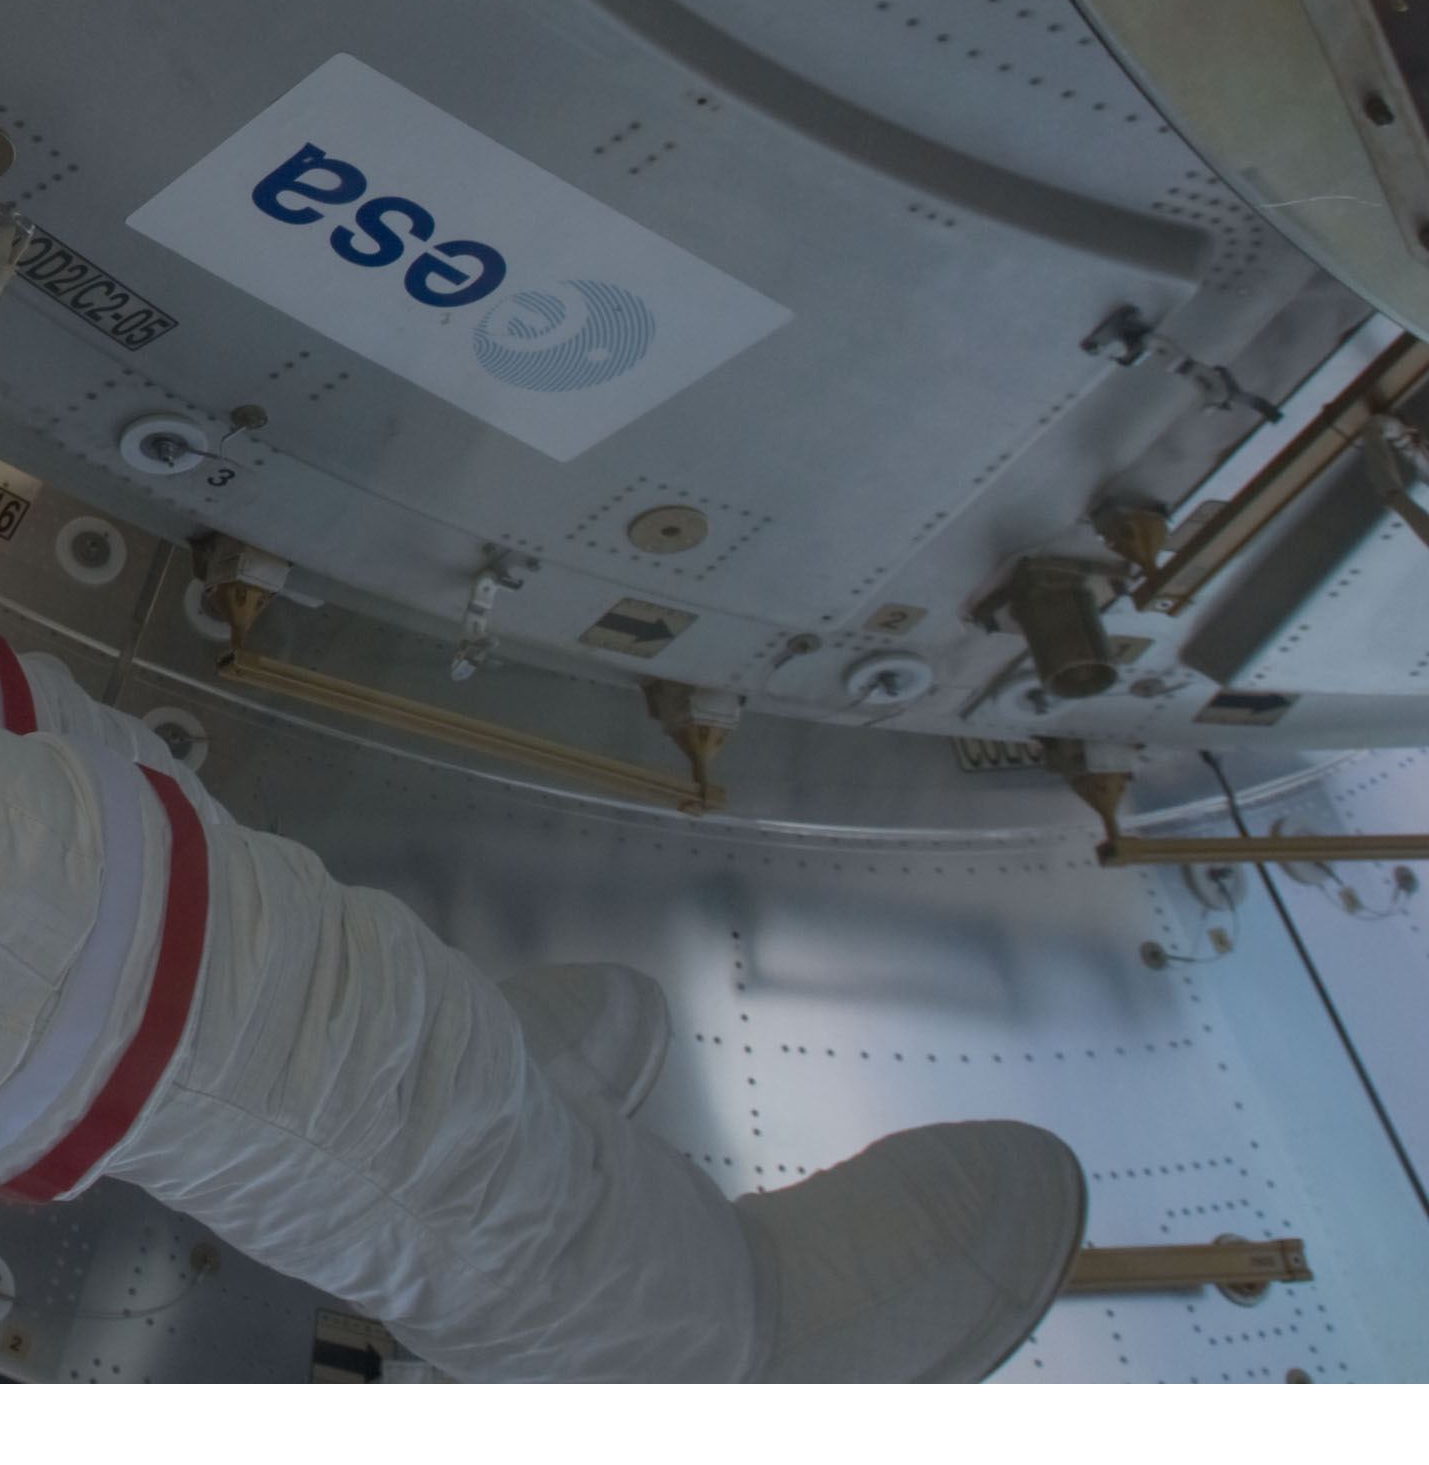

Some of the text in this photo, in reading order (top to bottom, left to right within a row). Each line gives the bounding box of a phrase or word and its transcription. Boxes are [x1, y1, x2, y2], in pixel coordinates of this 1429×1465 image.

[250, 141, 507, 309] esa
[207, 468, 236, 487] 3
[879, 610, 910, 631] 2
[9, 1334, 23, 1353] 2
